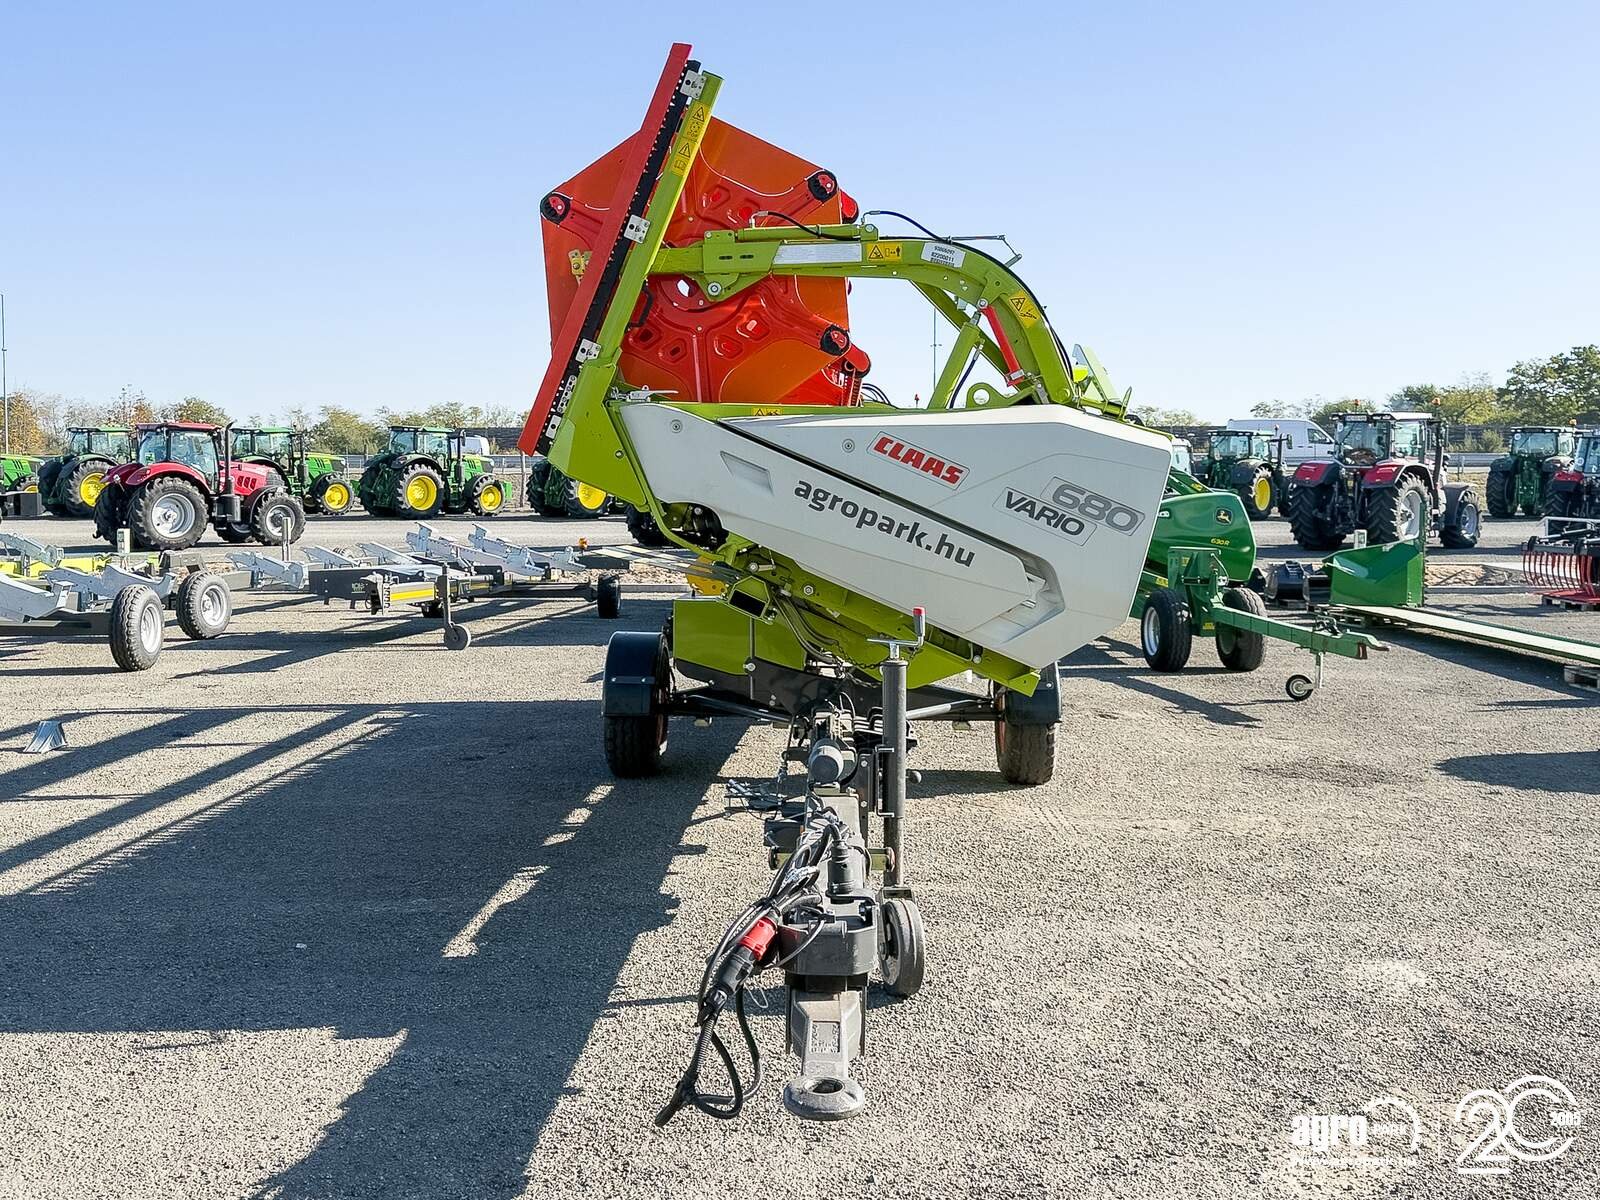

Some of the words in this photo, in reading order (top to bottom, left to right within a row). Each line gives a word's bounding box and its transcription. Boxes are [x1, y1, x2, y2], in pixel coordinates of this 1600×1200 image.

[873, 436, 964, 485] CLAAS
[794, 480, 976, 567] agropark.hu
[1004, 491, 1085, 536] VARIO
[1051, 483, 1139, 533] 680
